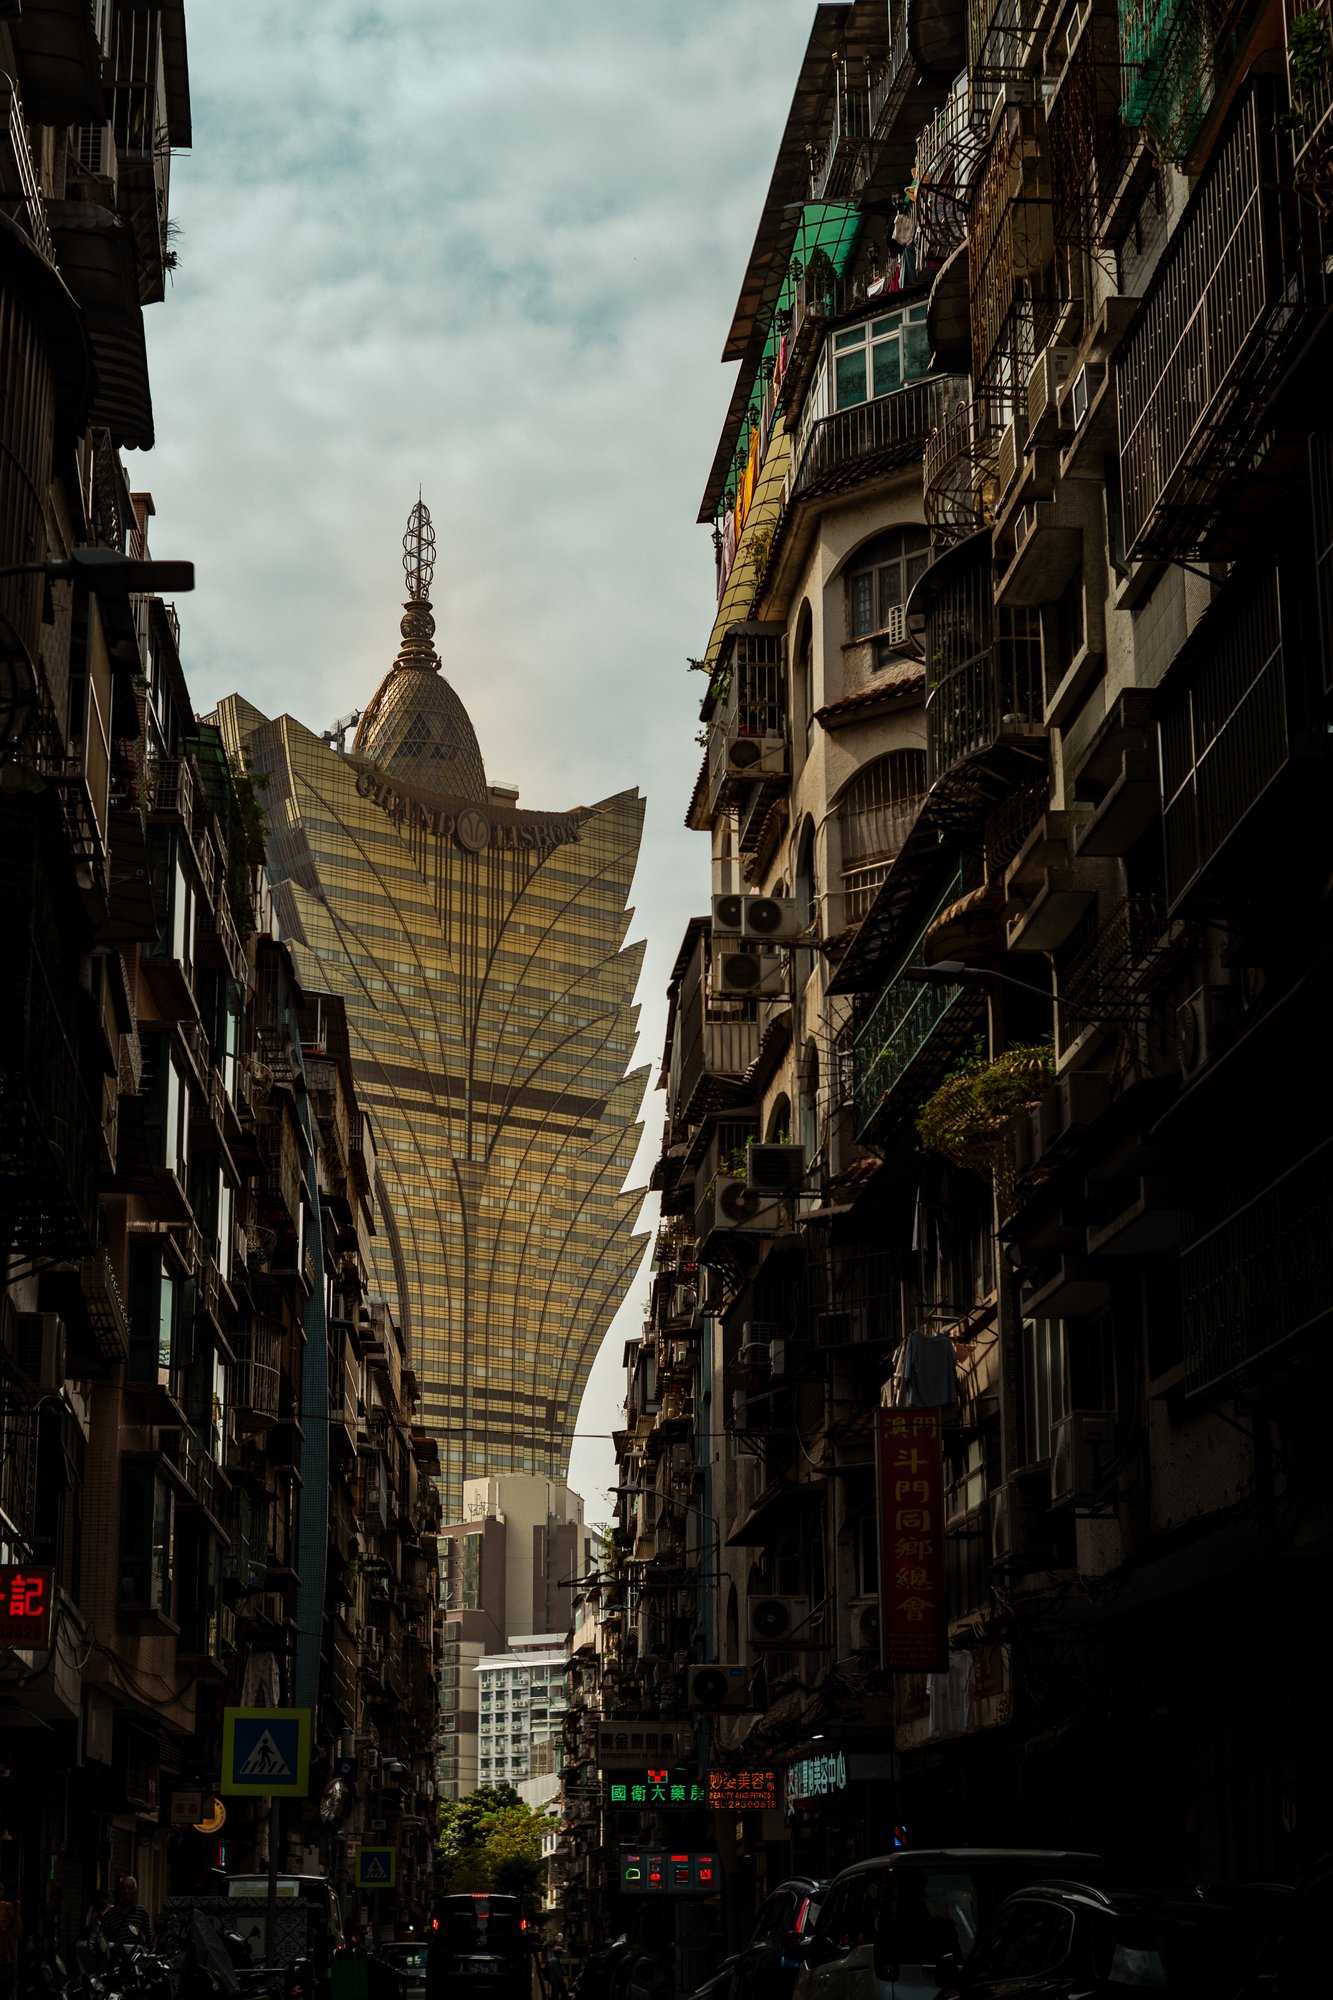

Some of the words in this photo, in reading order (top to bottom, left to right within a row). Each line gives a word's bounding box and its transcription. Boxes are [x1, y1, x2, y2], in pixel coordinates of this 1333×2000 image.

[356, 772, 455, 836] GRAND
[496, 819, 582, 850] LISBOA
[884, 1416, 937, 1439] 澳門
[893, 1447, 936, 1623] 斗門同鄉總會
[0, 1574, 45, 1617] 記
